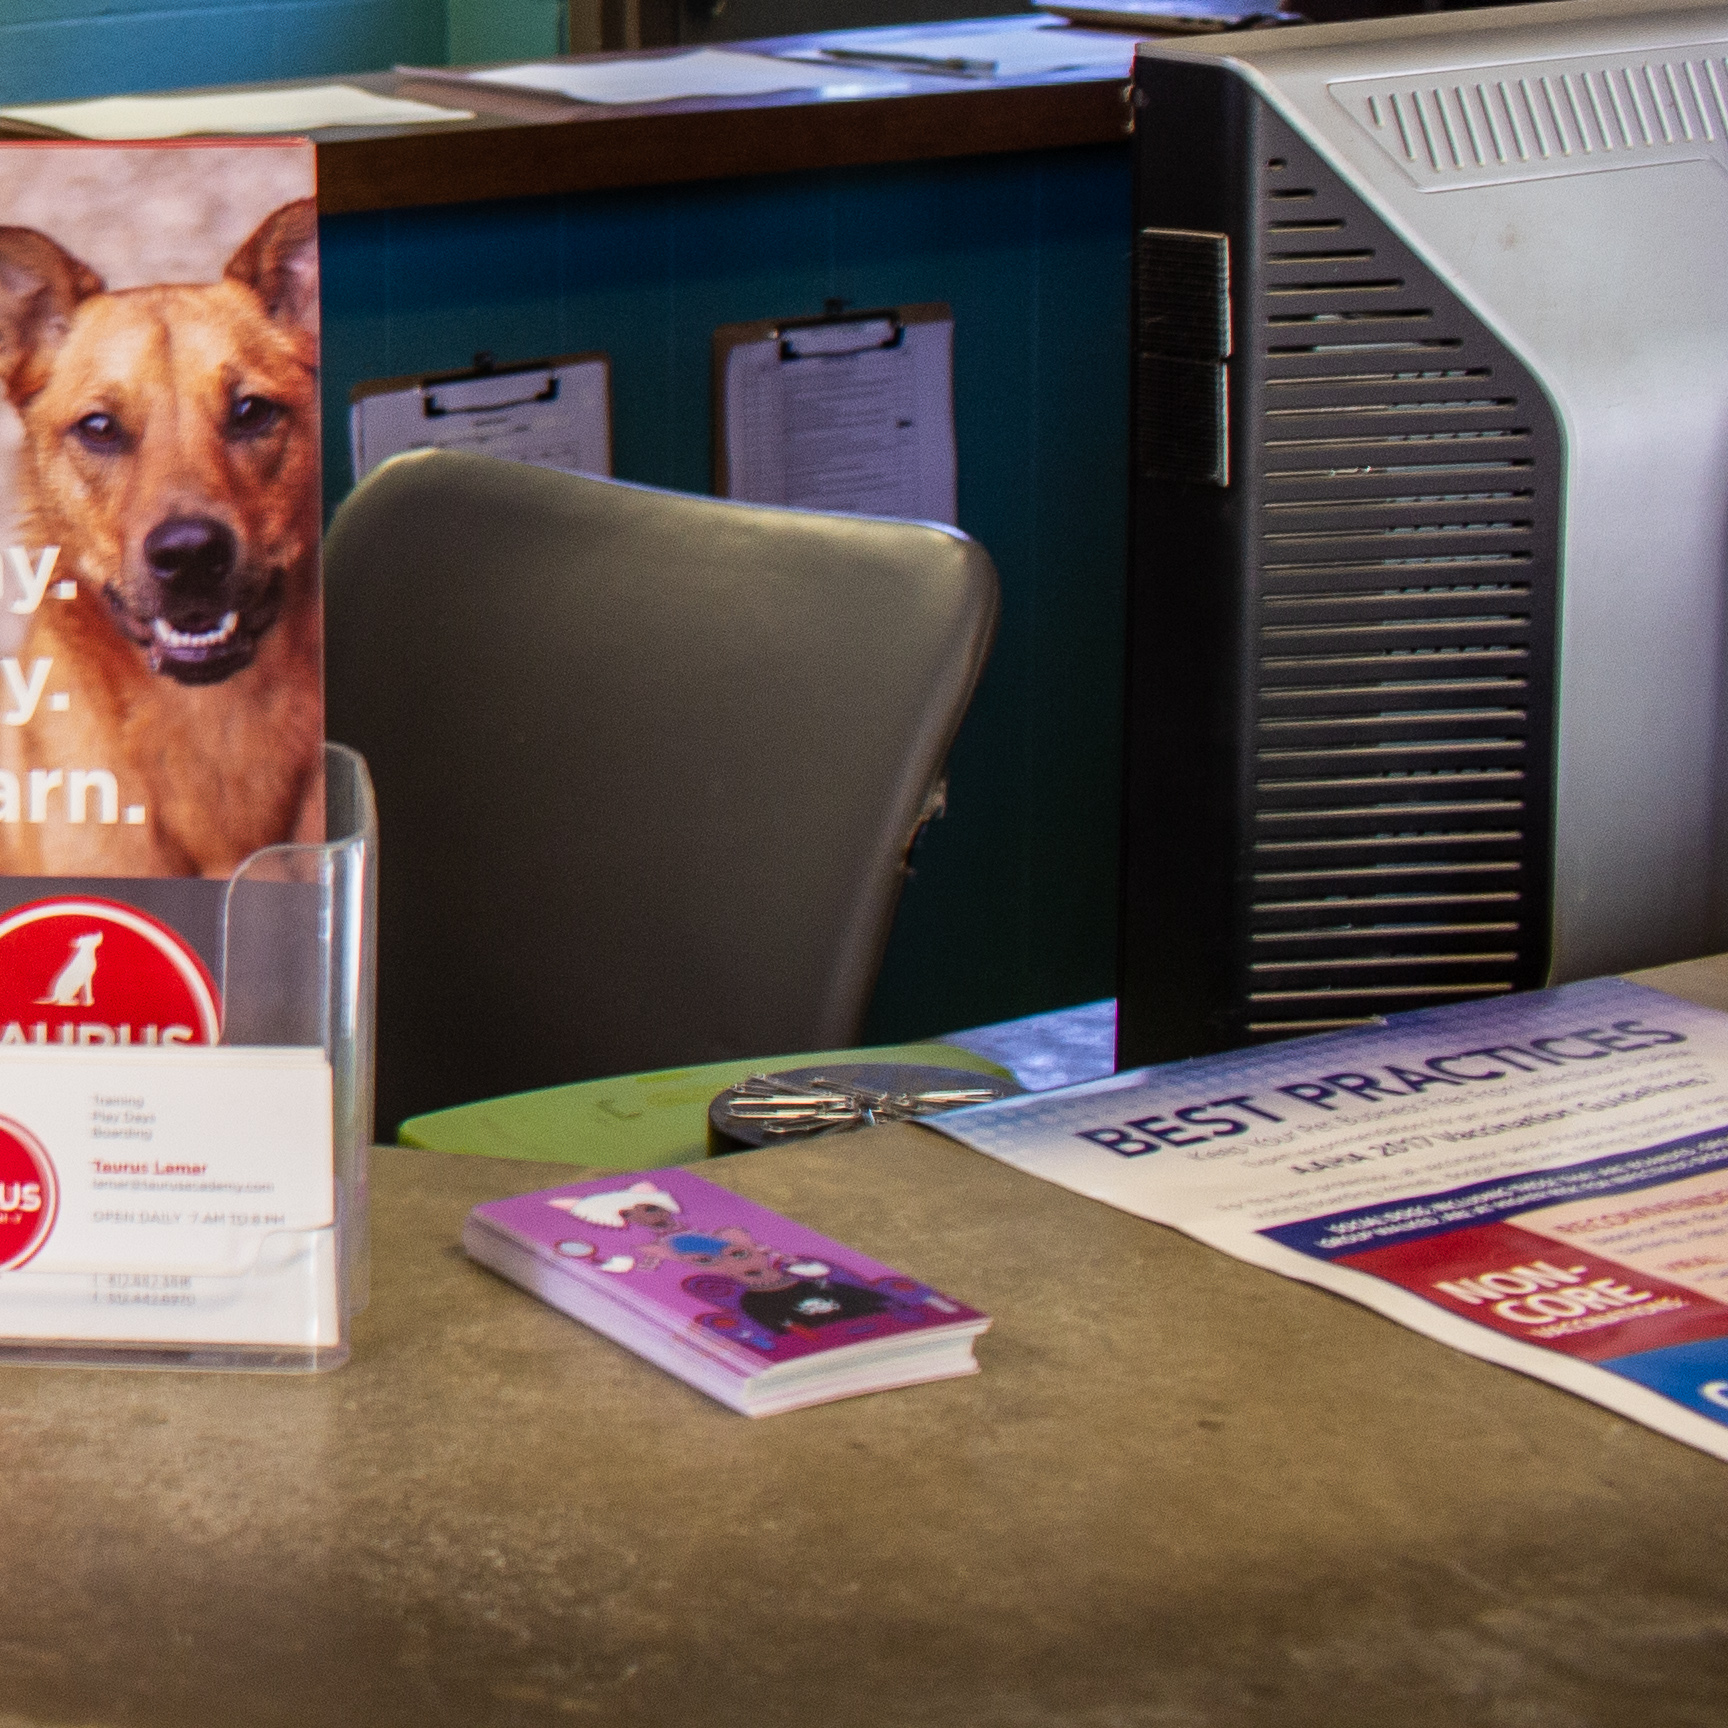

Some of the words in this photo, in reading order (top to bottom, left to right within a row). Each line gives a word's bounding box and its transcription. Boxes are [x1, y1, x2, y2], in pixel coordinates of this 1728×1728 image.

[1076, 1093, 1284, 1158] BEST
[1276, 1020, 1689, 1111] PRACTICES
[90, 1159, 148, 1175] Taurus
[1433, 1262, 1587, 1305] NON-
[1494, 1278, 1652, 1325] CORE
